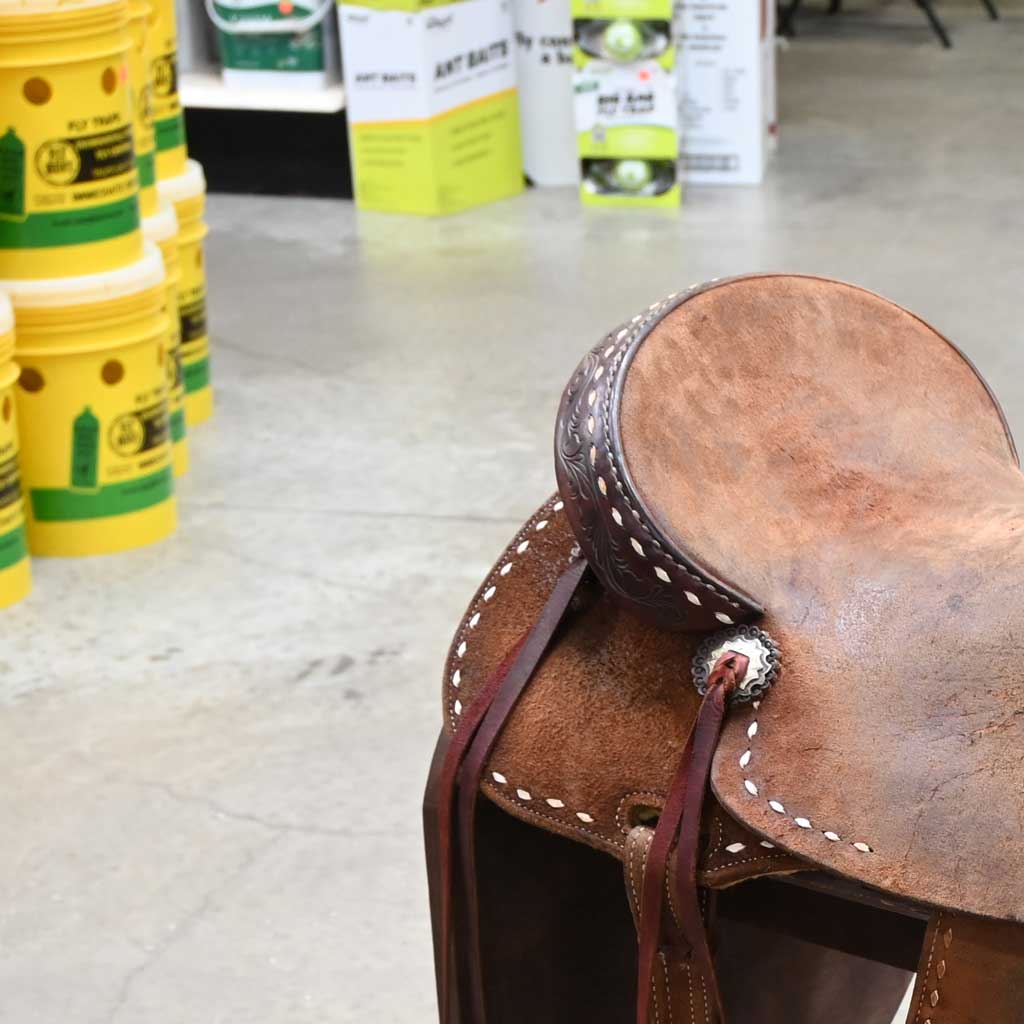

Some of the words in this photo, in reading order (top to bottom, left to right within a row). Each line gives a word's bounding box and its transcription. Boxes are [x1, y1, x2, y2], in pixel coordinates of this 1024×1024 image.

[435, 54, 463, 80] ANT
[468, 38, 508, 68] BAITS
[355, 72, 378, 83] ANT
[381, 72, 416, 83] BAITS
